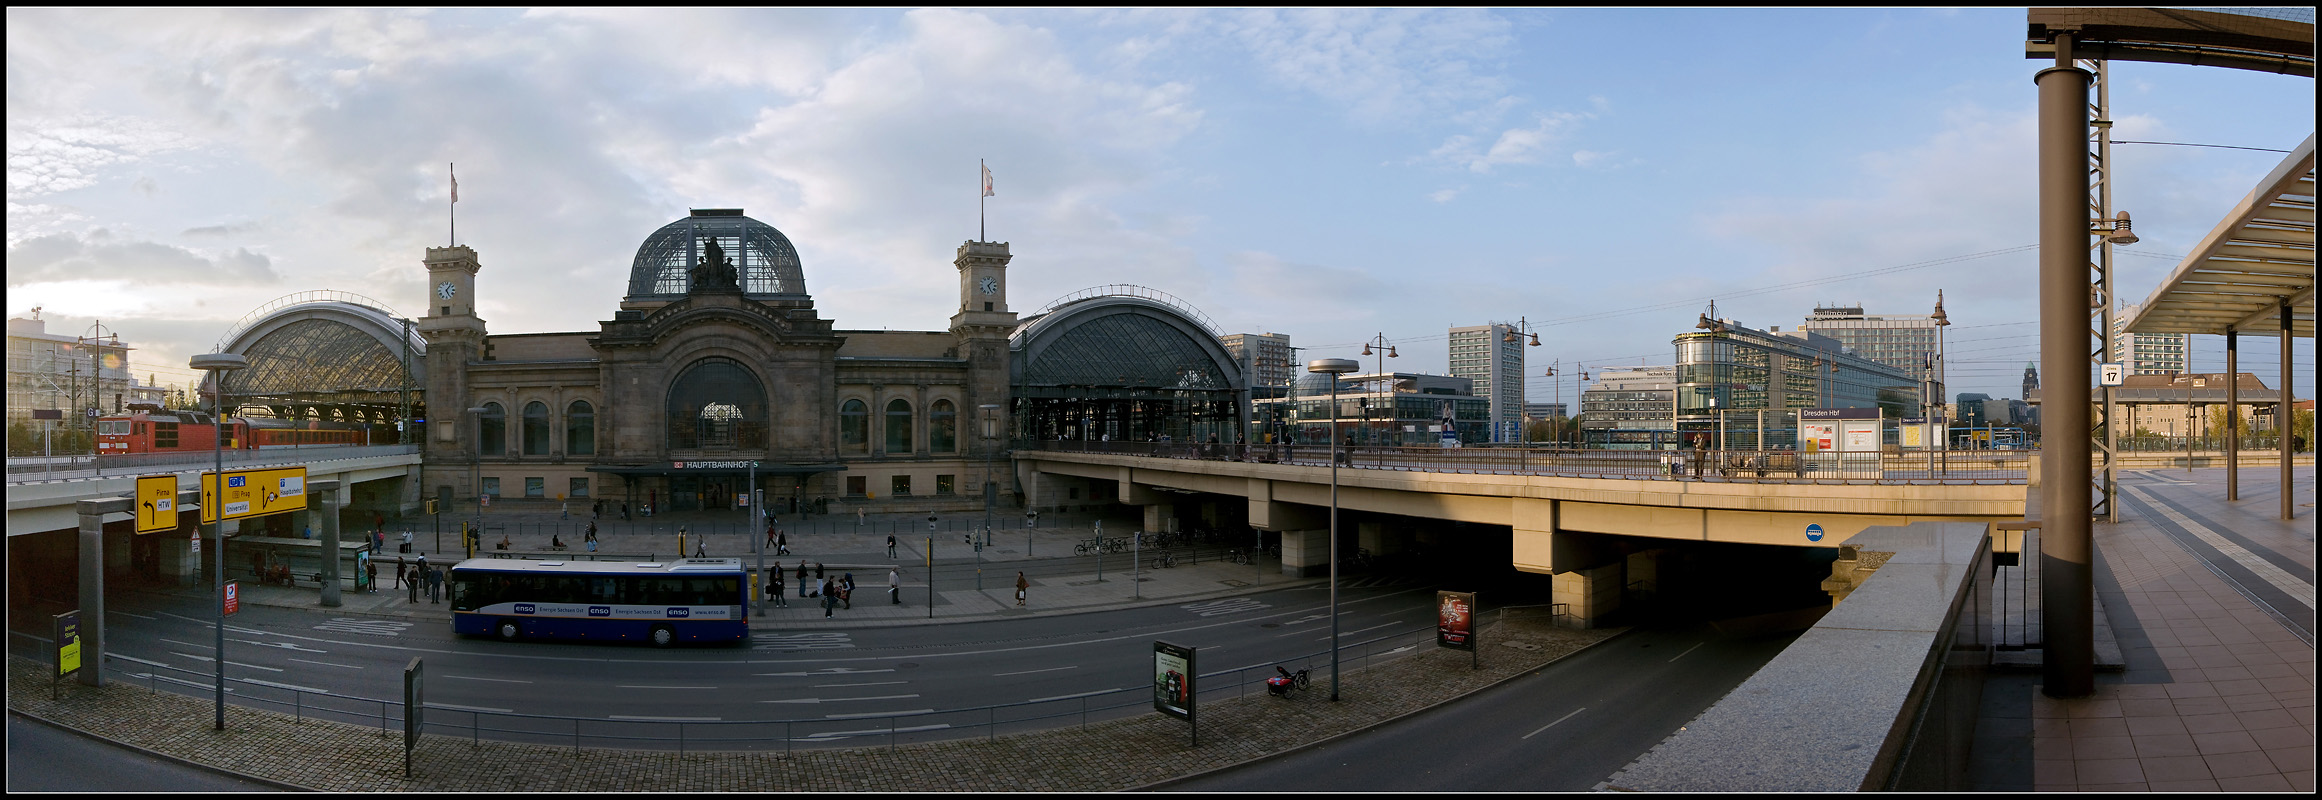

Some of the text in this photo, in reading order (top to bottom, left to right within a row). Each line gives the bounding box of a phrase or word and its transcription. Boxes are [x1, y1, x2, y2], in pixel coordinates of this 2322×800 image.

[2106, 372, 2118, 382] 17
[88, 408, 94, 417] G
[687, 461, 748, 469] HAUPTBAHNHOF
[241, 490, 250, 498] Prag
[157, 500, 171, 509] HTW
